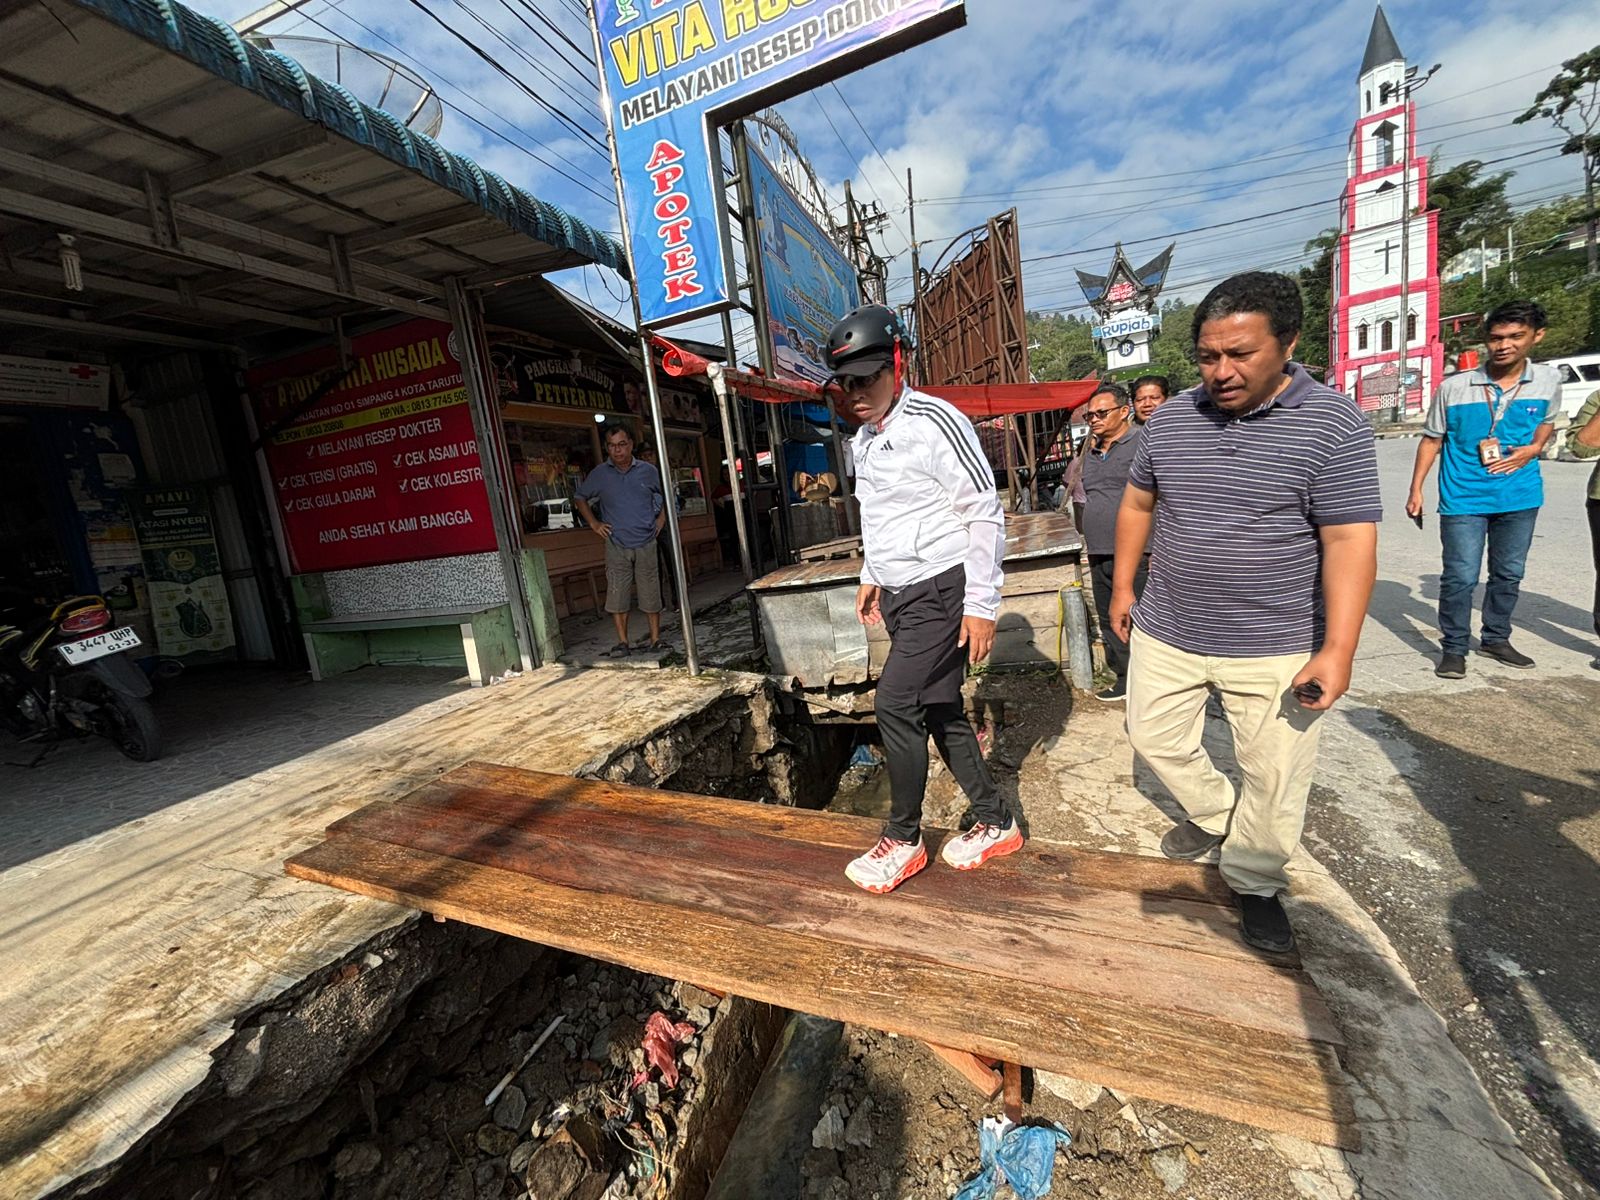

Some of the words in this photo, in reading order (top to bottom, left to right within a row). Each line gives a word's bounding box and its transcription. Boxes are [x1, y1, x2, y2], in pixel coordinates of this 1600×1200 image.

[610, 0, 716, 86] VITA
[622, 57, 737, 127] MELAYANI
[740, 19, 819, 76] RESEP
[646, 142, 702, 300] APOTEK
[372, 337, 447, 380] HUSADA
[356, 390, 394, 408] SIMPANG
[401, 383, 427, 397] KOTA
[411, 398, 431, 412] 0813
[433, 392, 453, 407] 7745
[534, 381, 587, 407] PETTER
[317, 435, 364, 457] MELAYANI
[365, 428, 397, 447] RESEP
[399, 417, 442, 439] DOKTER
[290, 473, 310, 488] CEK
[309, 466, 336, 485] TENSI
[336, 460, 378, 482] (GRATIS)
[405, 450, 427, 467] CEK
[428, 443, 459, 462] ASAM
[295, 497, 315, 511] CEK
[315, 492, 342, 508] GULA
[342, 486, 376, 503] DARAH
[410, 475, 433, 492] CEK
[433, 467, 483, 488] KOLESTR
[319, 528, 348, 543] ANDA
[350, 521, 385, 539] SEHAT
[388, 516, 418, 534] KAMI
[419, 508, 473, 529] BANGGA
[63, 646, 74, 655] B
[77, 635, 106, 652] 3447
[109, 628, 131, 641] UHP
